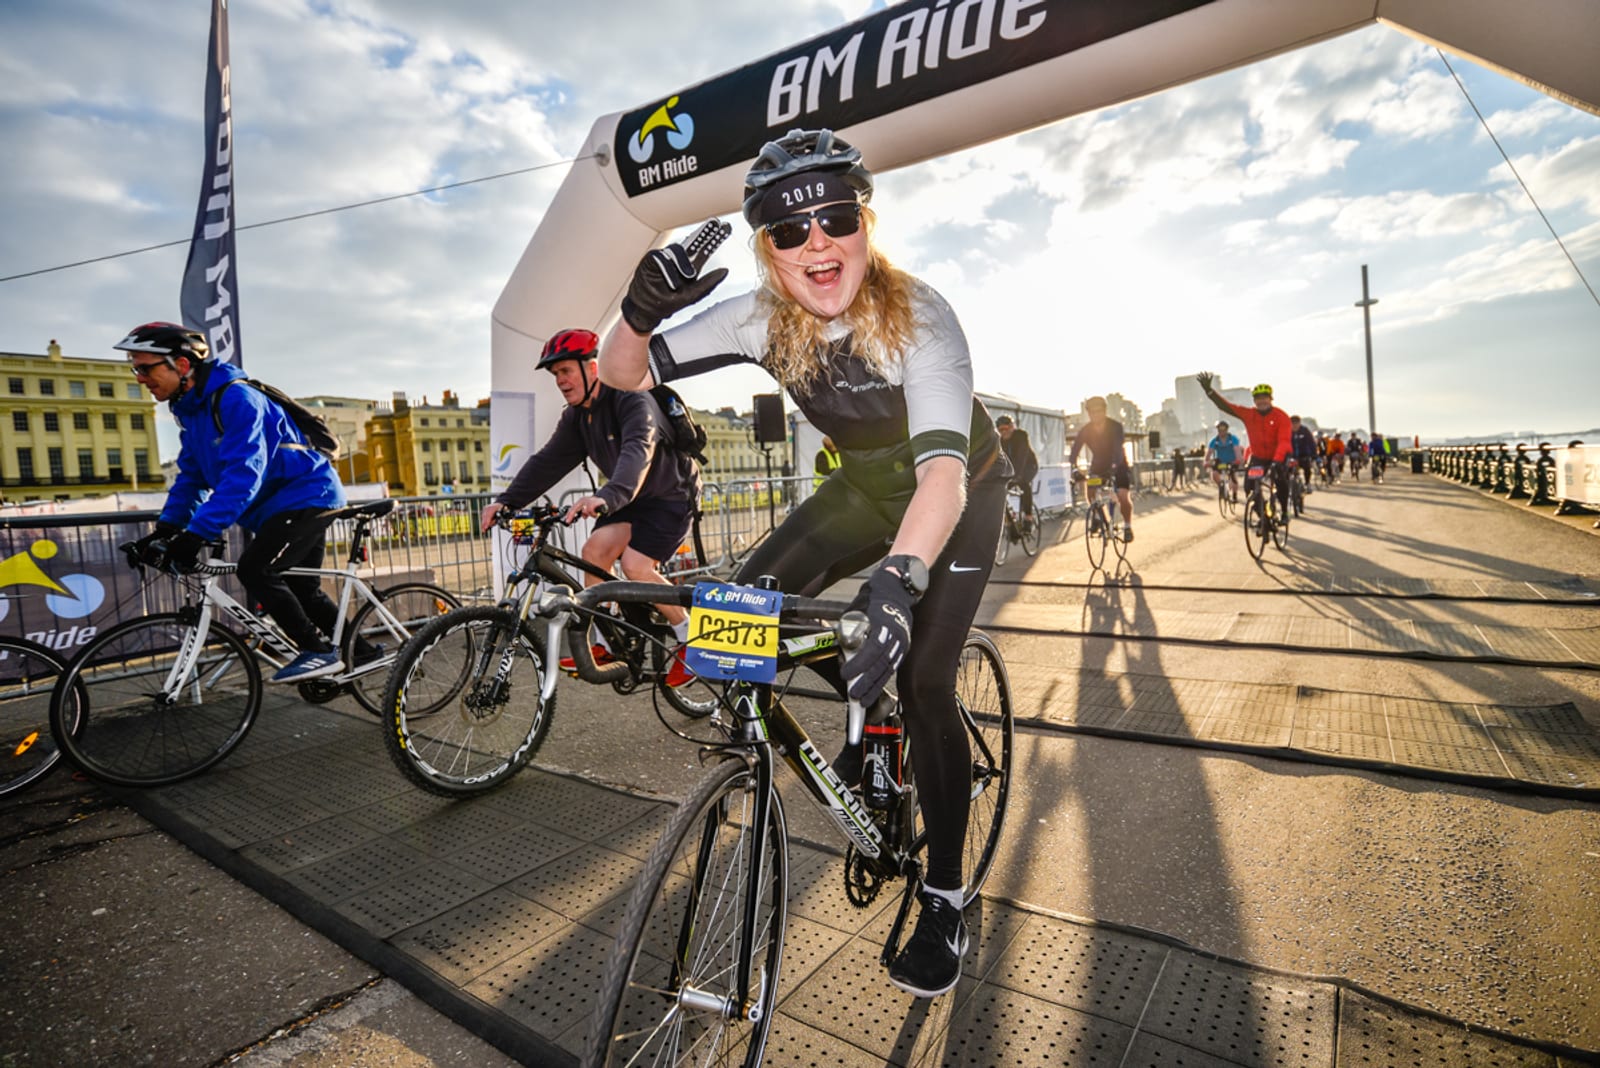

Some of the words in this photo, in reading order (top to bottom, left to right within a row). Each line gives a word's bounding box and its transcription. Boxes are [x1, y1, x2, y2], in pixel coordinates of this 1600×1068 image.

[767, 32, 864, 127] BM
[876, 0, 1047, 88] Ride
[638, 164, 662, 188] BM
[663, 154, 697, 181] Ride
[782, 182, 826, 206] 2019
[724, 591, 741, 603] BM
[741, 593, 767, 606] Ride
[699, 614, 767, 648] C2573
[799, 740, 883, 844] MERIDA
[835, 808, 878, 854] MERIDA
